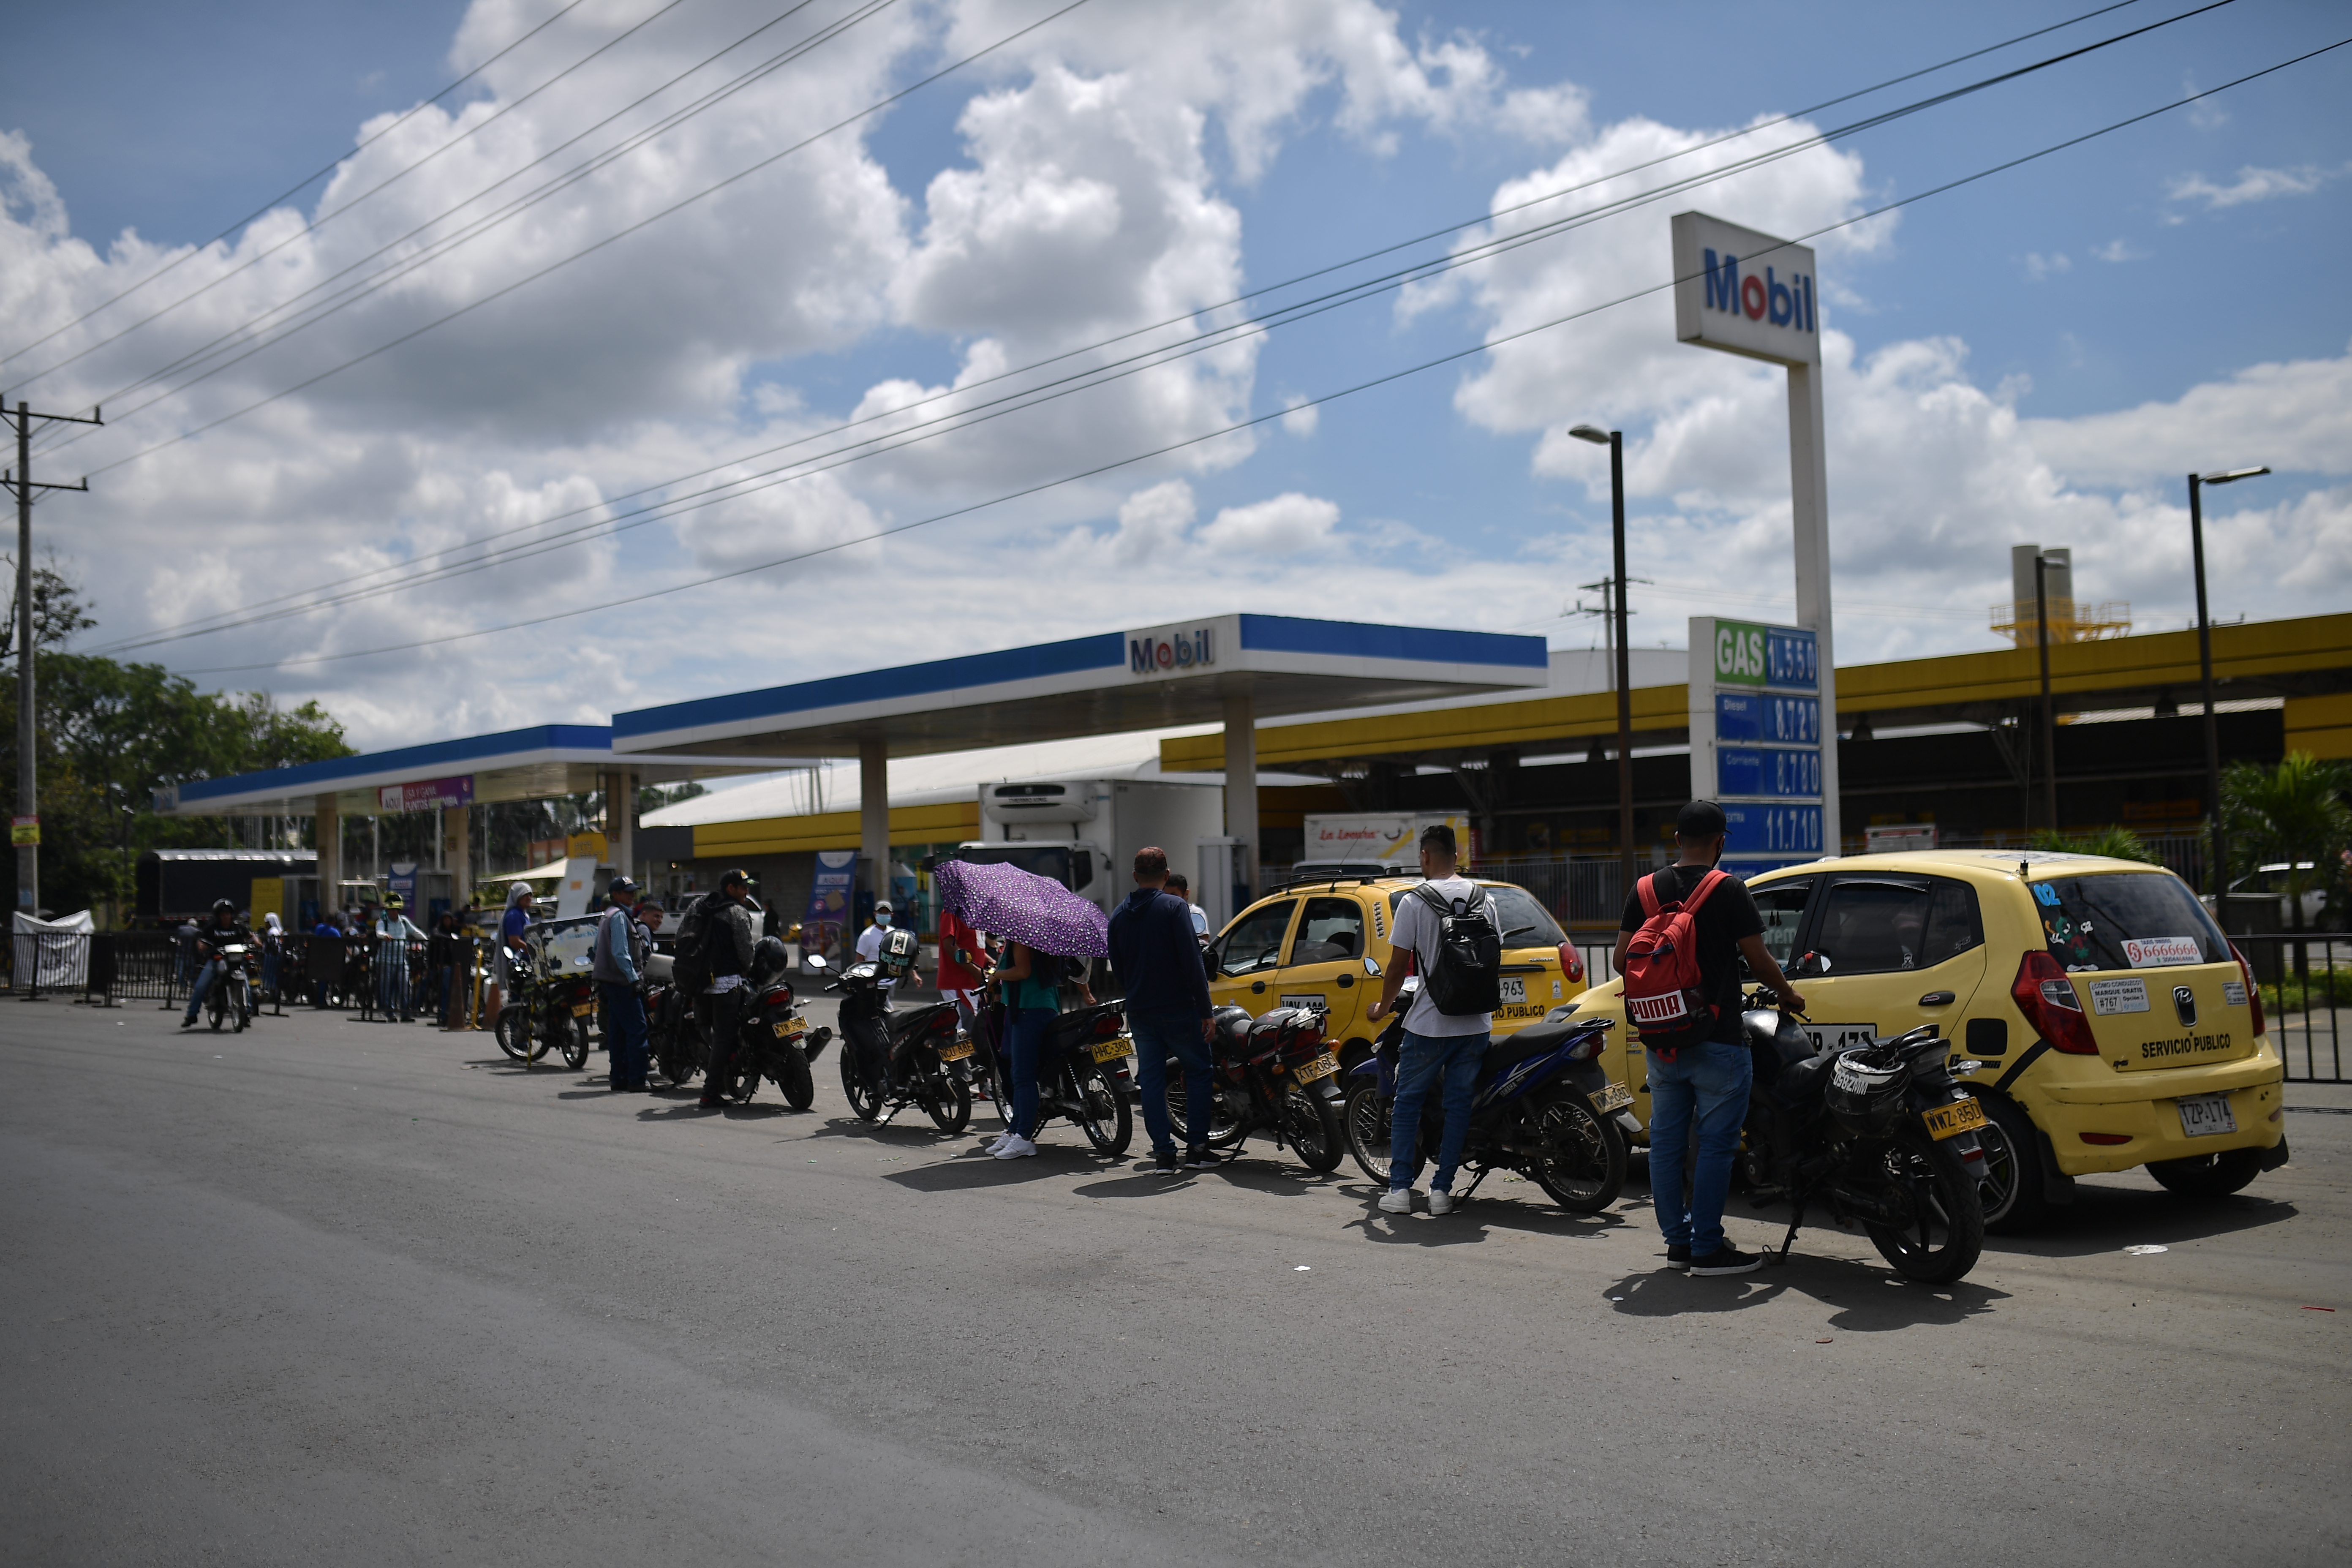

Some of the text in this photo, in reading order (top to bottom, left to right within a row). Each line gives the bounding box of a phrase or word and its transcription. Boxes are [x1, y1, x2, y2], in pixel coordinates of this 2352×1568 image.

[1705, 248, 1813, 332] Mobil
[1131, 629, 1211, 672] Mobil
[1716, 629, 1816, 680] GAS 1.550
[1724, 700, 1817, 741] Diesel 8.720
[1726, 754, 1760, 766] Corriente
[1767, 810, 1817, 850] 11.710
[2144, 943, 2197, 958] 6666666
[1507, 1005, 1545, 1018] PUBLICO
[1629, 994, 1681, 1019] PUMA
[2100, 997, 2118, 1008] #767
[2142, 1033, 2231, 1059] SERVICIO PUBLICO
[1499, 1082, 1518, 1097] YAMAHA
